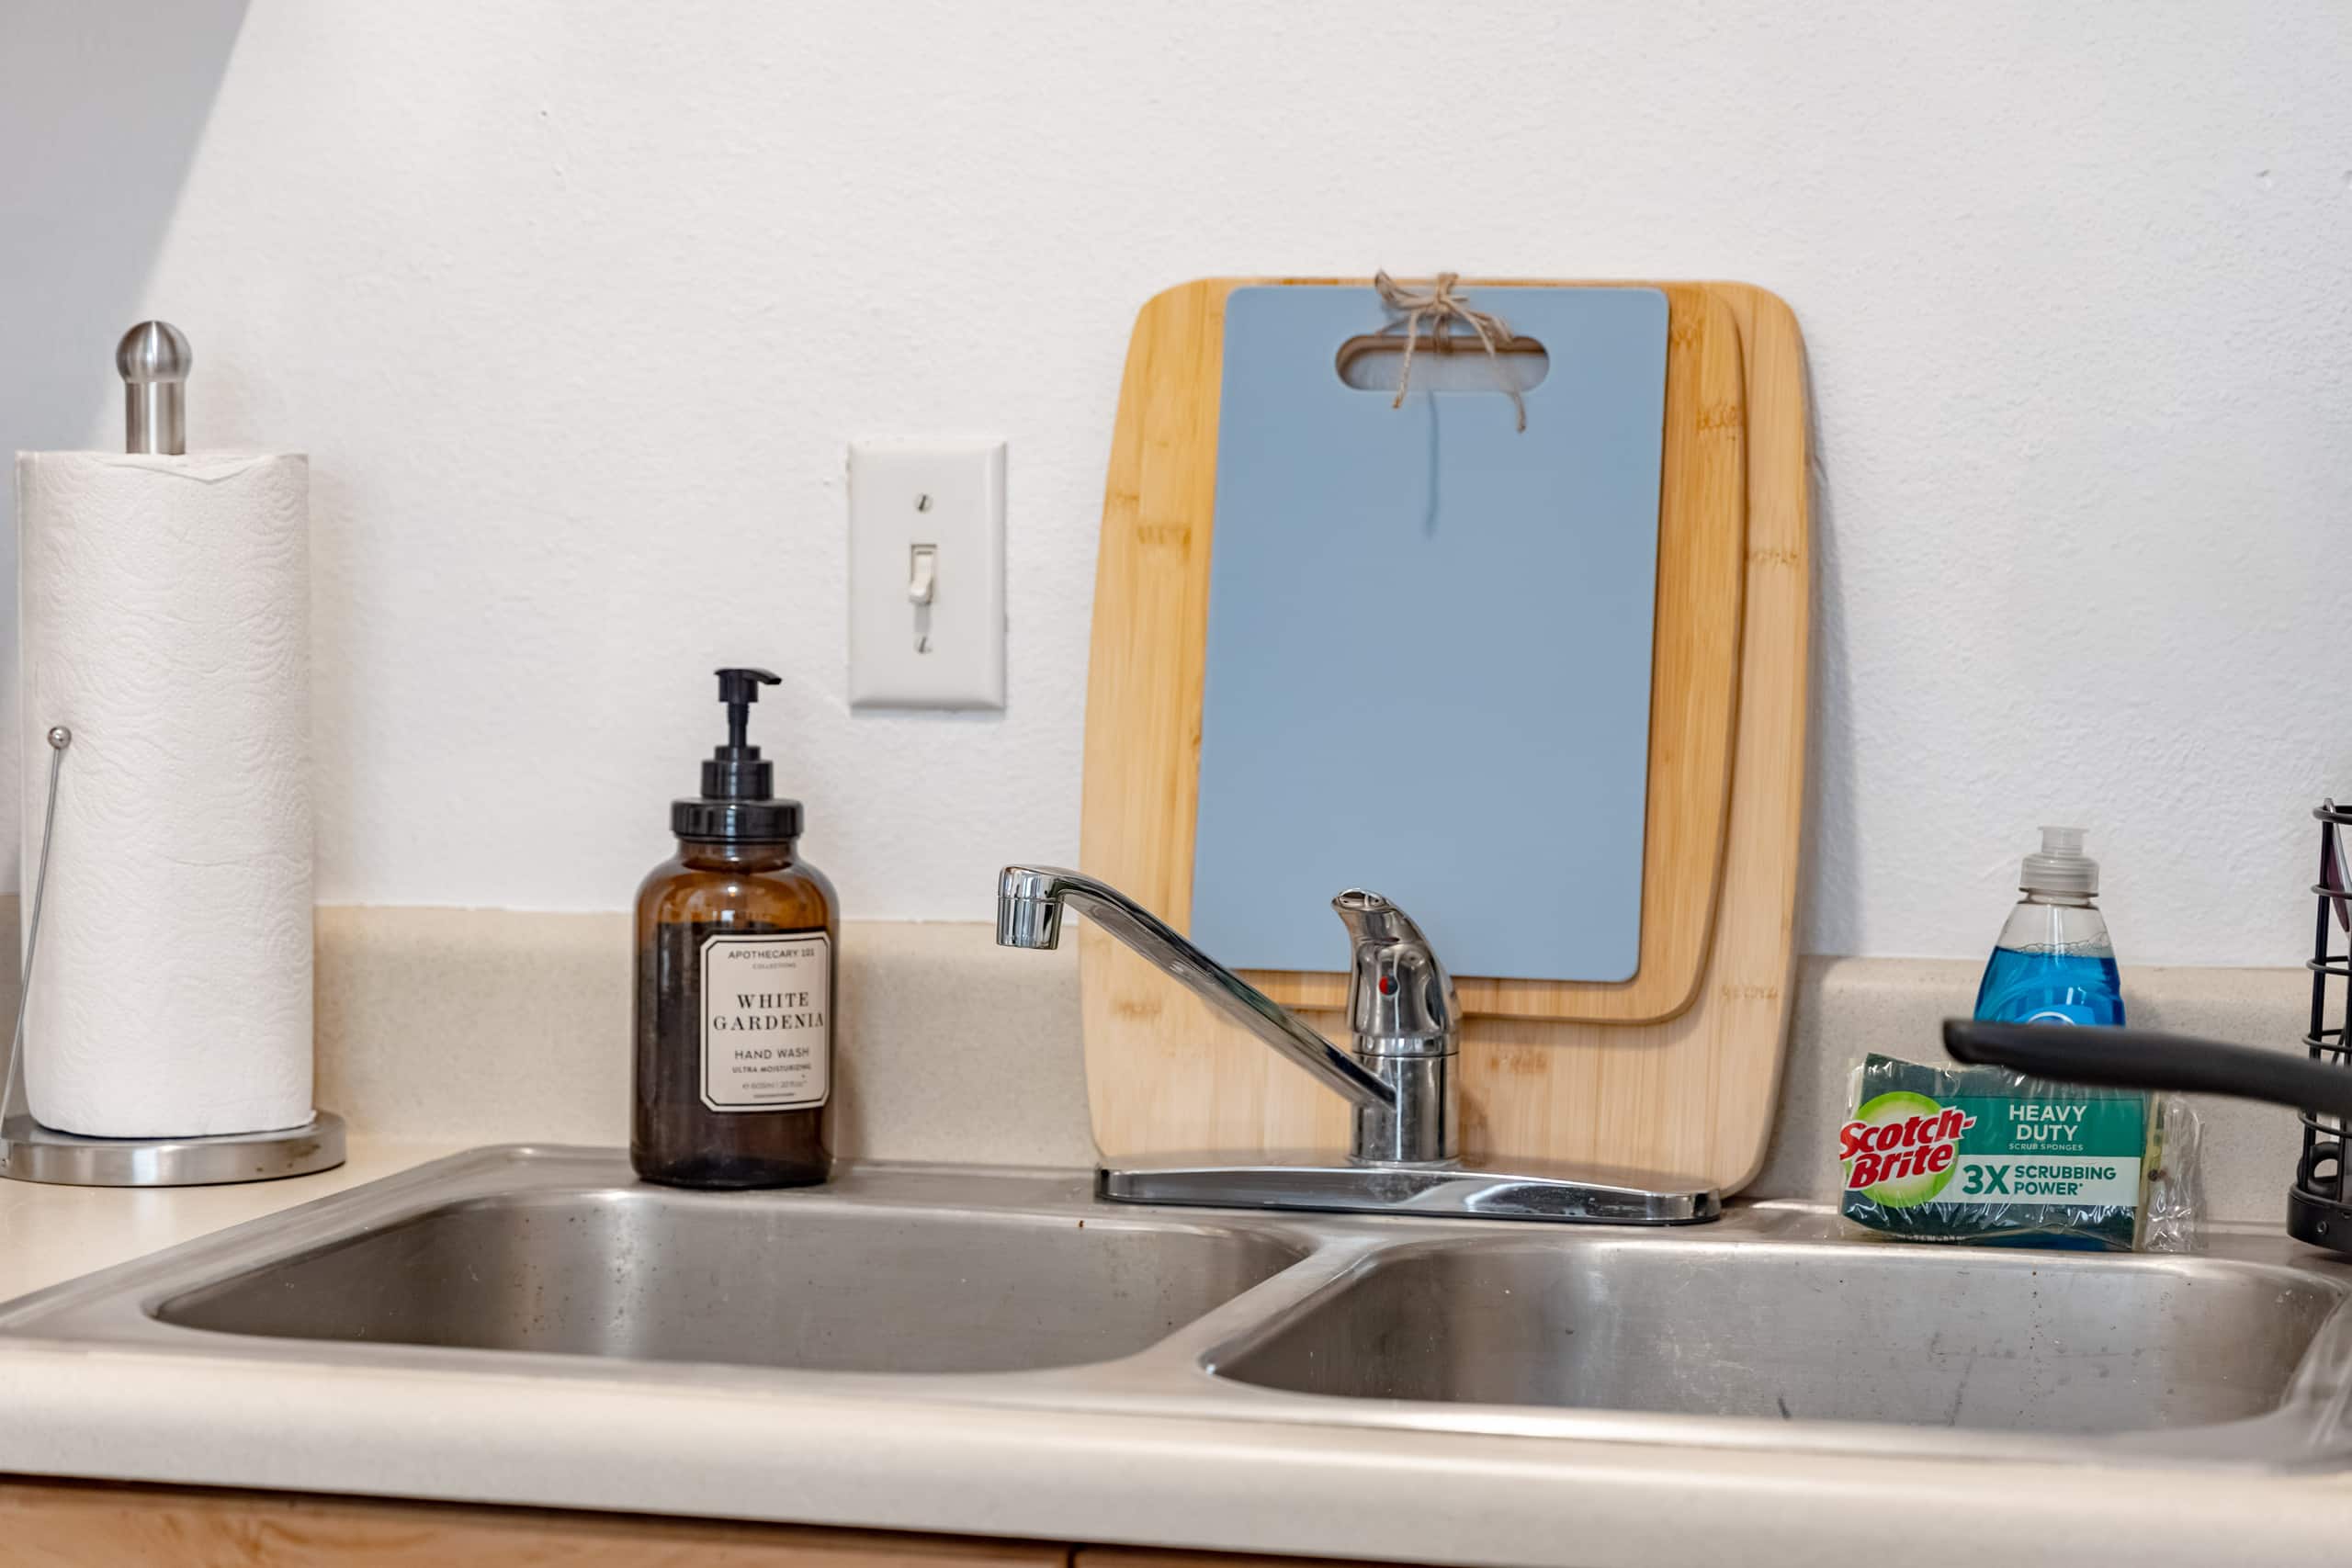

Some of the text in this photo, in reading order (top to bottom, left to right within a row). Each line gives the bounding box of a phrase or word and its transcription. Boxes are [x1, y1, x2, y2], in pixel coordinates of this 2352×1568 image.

[728, 949, 798, 960] APOTHECARY
[737, 992, 809, 1009] WHITE
[713, 1012, 824, 1031] GARDENIA
[735, 1047, 809, 1059] HAND WASH
[2008, 1104, 2087, 1122] HEAVY
[2016, 1124, 2078, 1141] DUTY
[2041, 1143, 2084, 1151] SPONGES
[1849, 1144, 1953, 1189] Brite
[1962, 1164, 2117, 1195] 3X SCRUBBING
